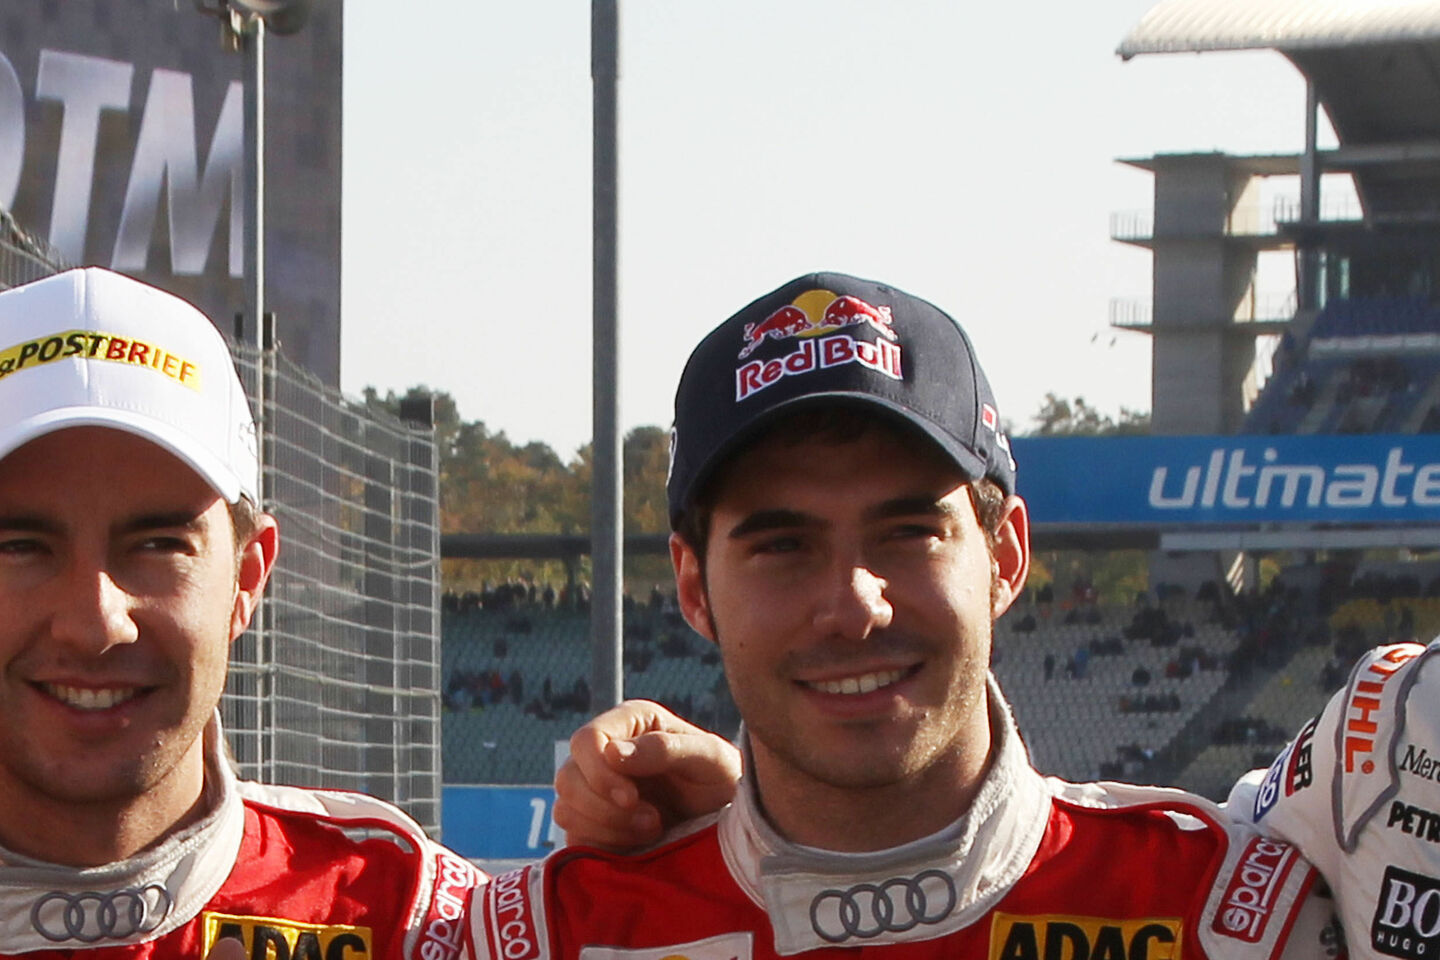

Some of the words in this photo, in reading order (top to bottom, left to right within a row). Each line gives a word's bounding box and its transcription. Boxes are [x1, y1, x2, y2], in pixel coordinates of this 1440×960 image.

[736, 338, 815, 402] Red
[820, 335, 904, 380] Bull
[1148, 447, 1440, 508] ultimate
[1345, 648, 1416, 773] STIHL
[492, 868, 531, 959] sparco
[1222, 838, 1287, 932] sparc
